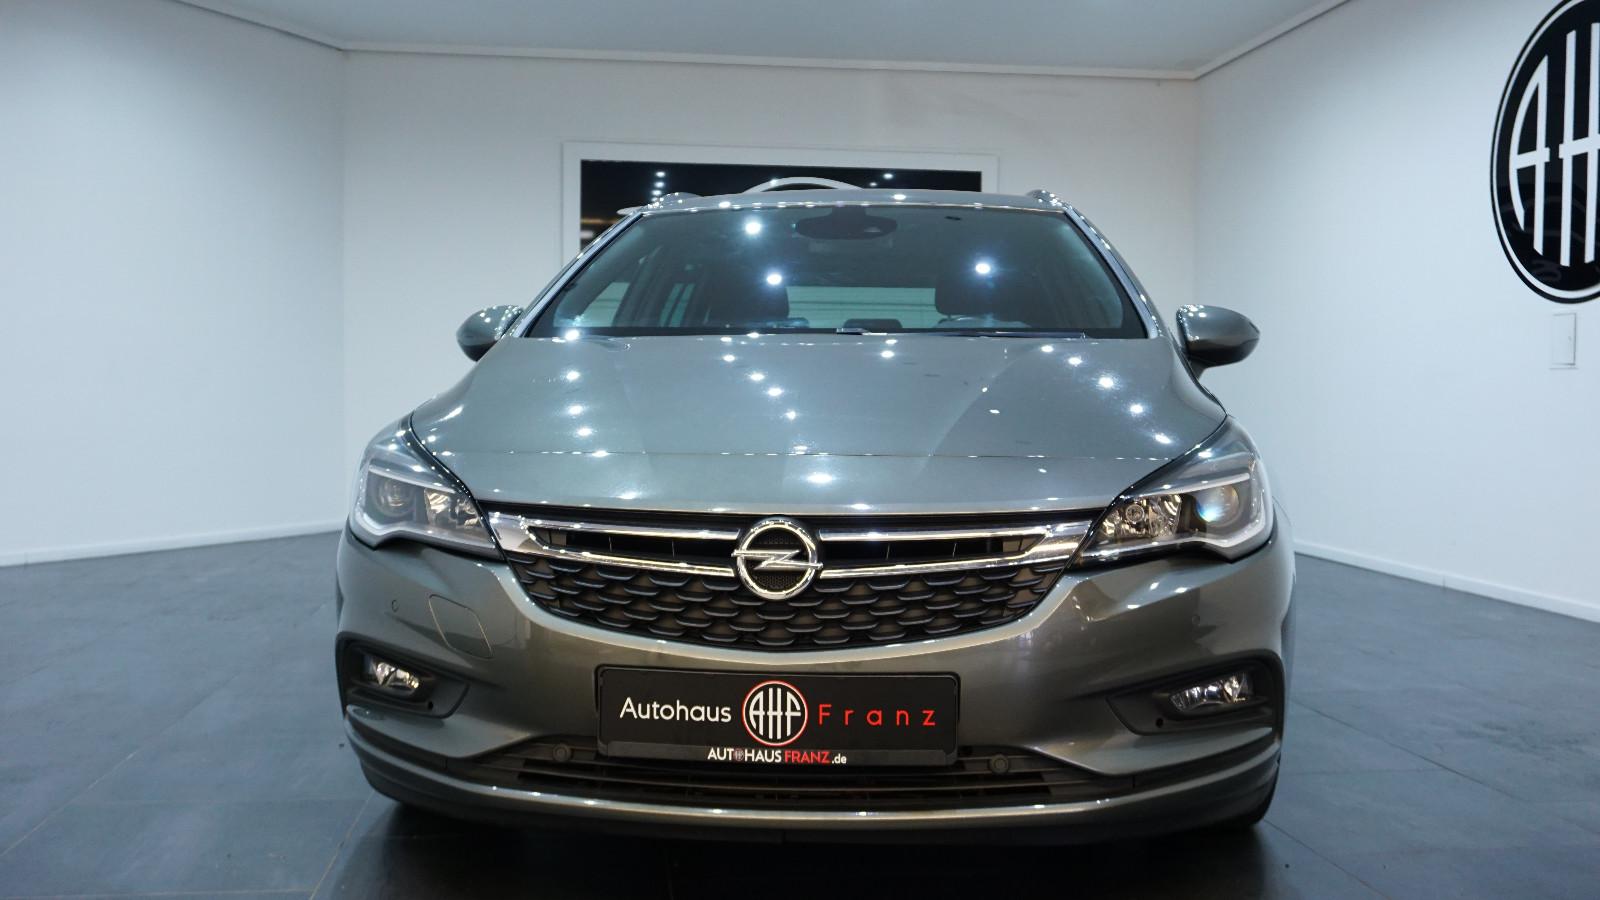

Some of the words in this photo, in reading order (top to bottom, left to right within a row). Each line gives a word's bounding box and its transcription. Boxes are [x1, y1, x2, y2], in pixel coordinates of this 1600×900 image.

[1508, 22, 1600, 267] AH
[619, 697, 732, 723] Autohaus
[817, 704, 936, 727] Franz
